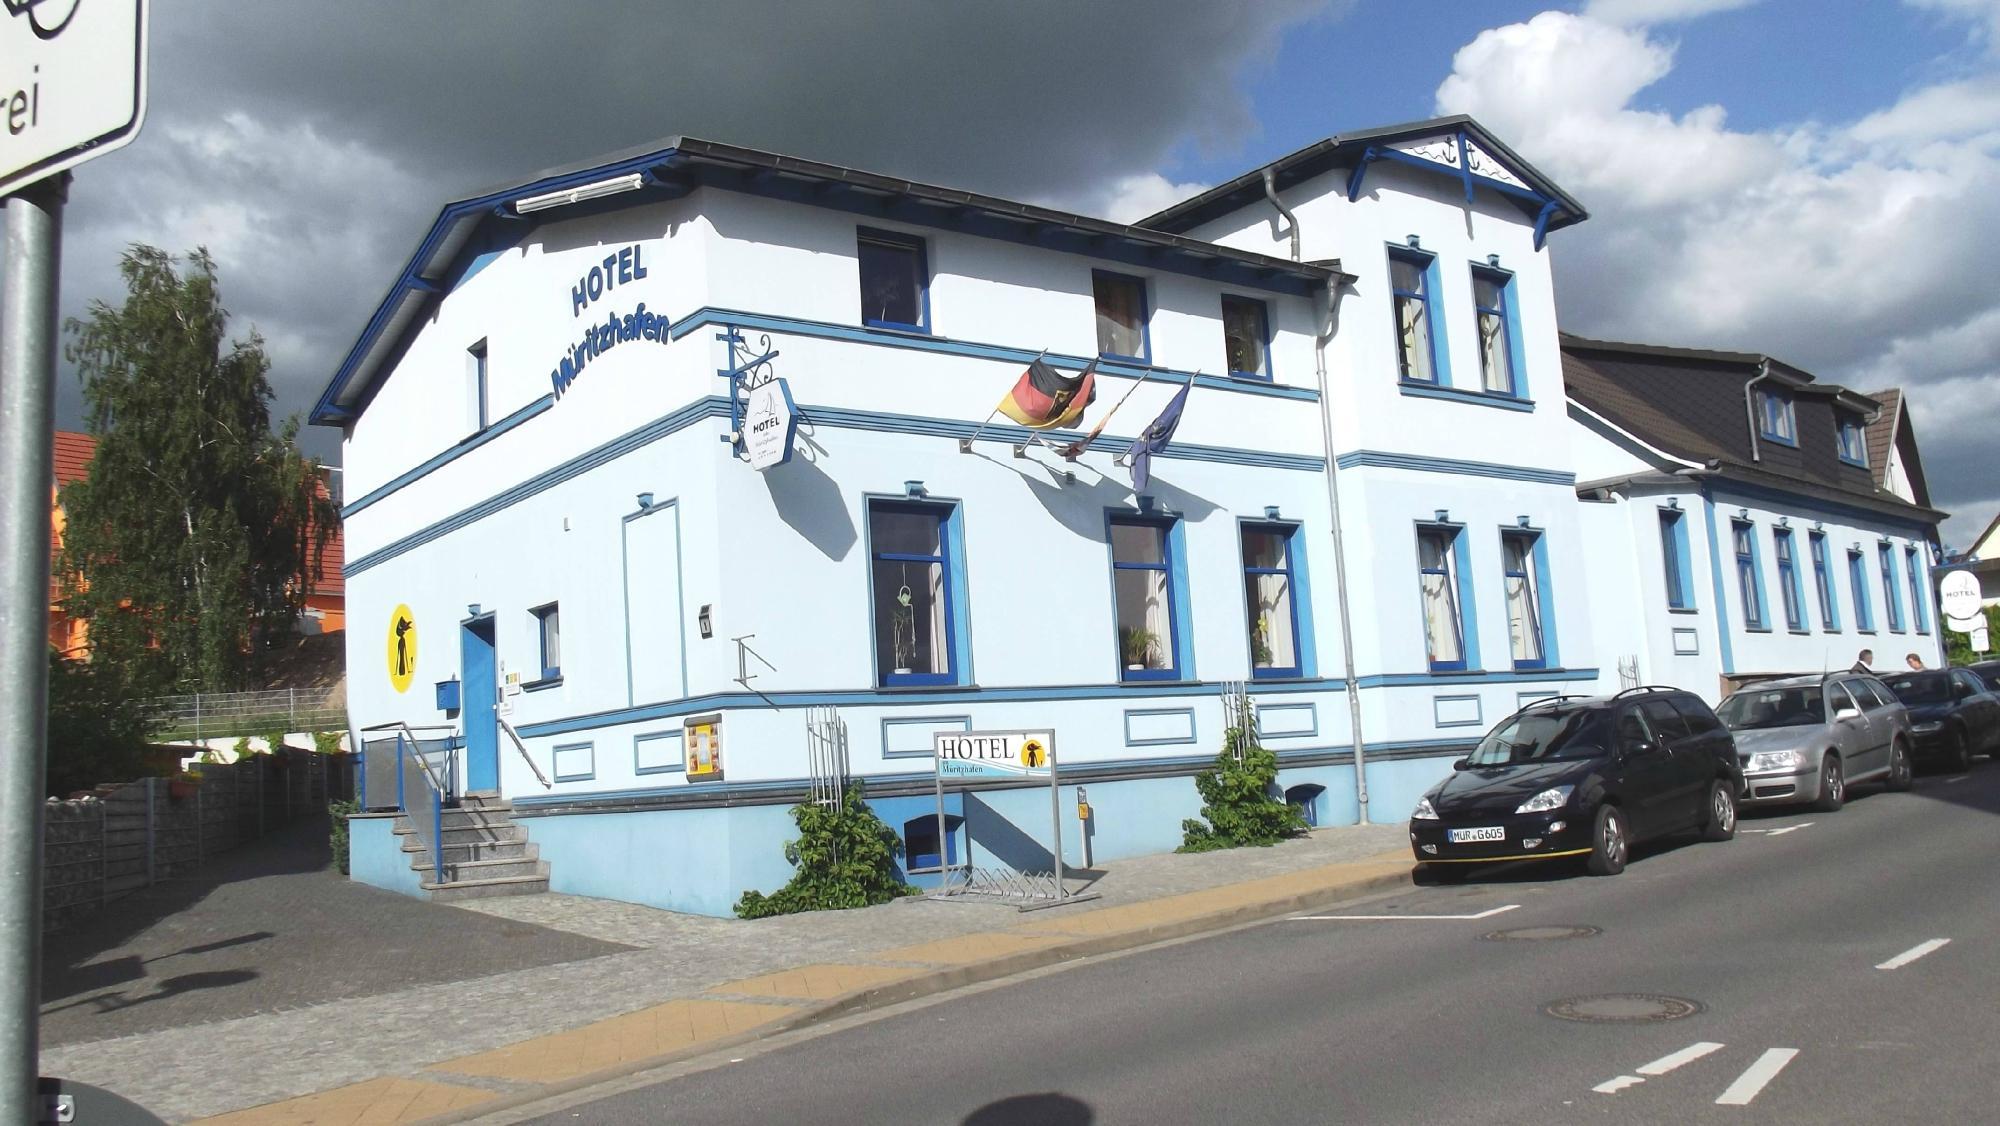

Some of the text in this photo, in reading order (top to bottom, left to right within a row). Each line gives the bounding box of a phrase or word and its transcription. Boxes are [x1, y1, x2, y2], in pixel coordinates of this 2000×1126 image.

[572, 244, 648, 318] HOTEL
[551, 302, 670, 401] Müritzhafen
[753, 417, 780, 434] HOTEL
[1946, 590, 1976, 598] HOTEL
[941, 738, 1014, 759] HOTEL
